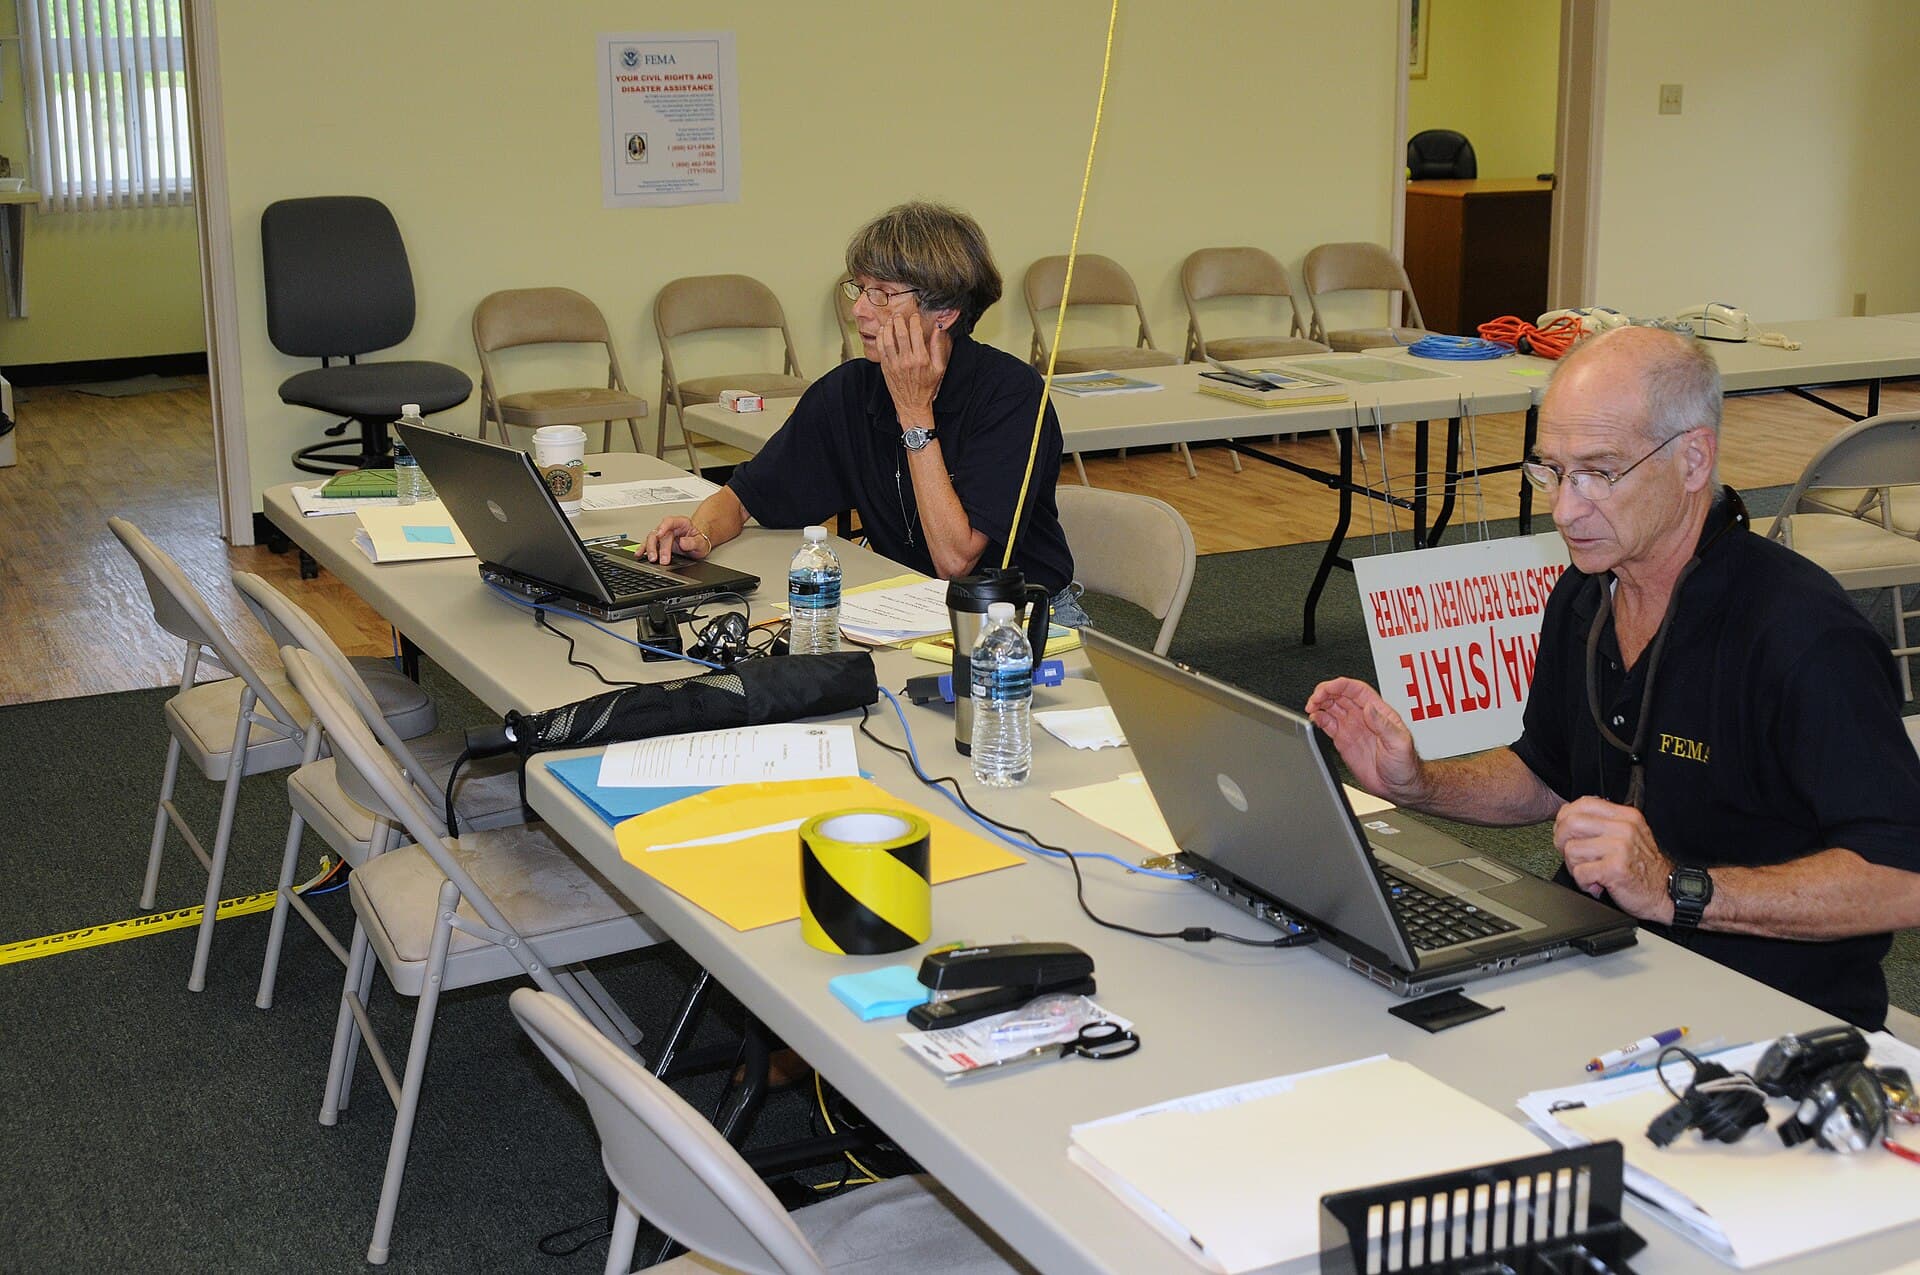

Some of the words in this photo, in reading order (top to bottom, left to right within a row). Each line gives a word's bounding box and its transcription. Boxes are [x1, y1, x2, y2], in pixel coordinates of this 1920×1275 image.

[645, 54, 676, 65] FEMA
[616, 74, 638, 82] YOUR
[664, 73, 694, 81] RIGHTS
[621, 85, 660, 93] DISASTER
[1369, 585, 1430, 638] CENTER
[1430, 574, 1504, 630] RECOVERY
[1400, 625, 1542, 721] MA/STATE
